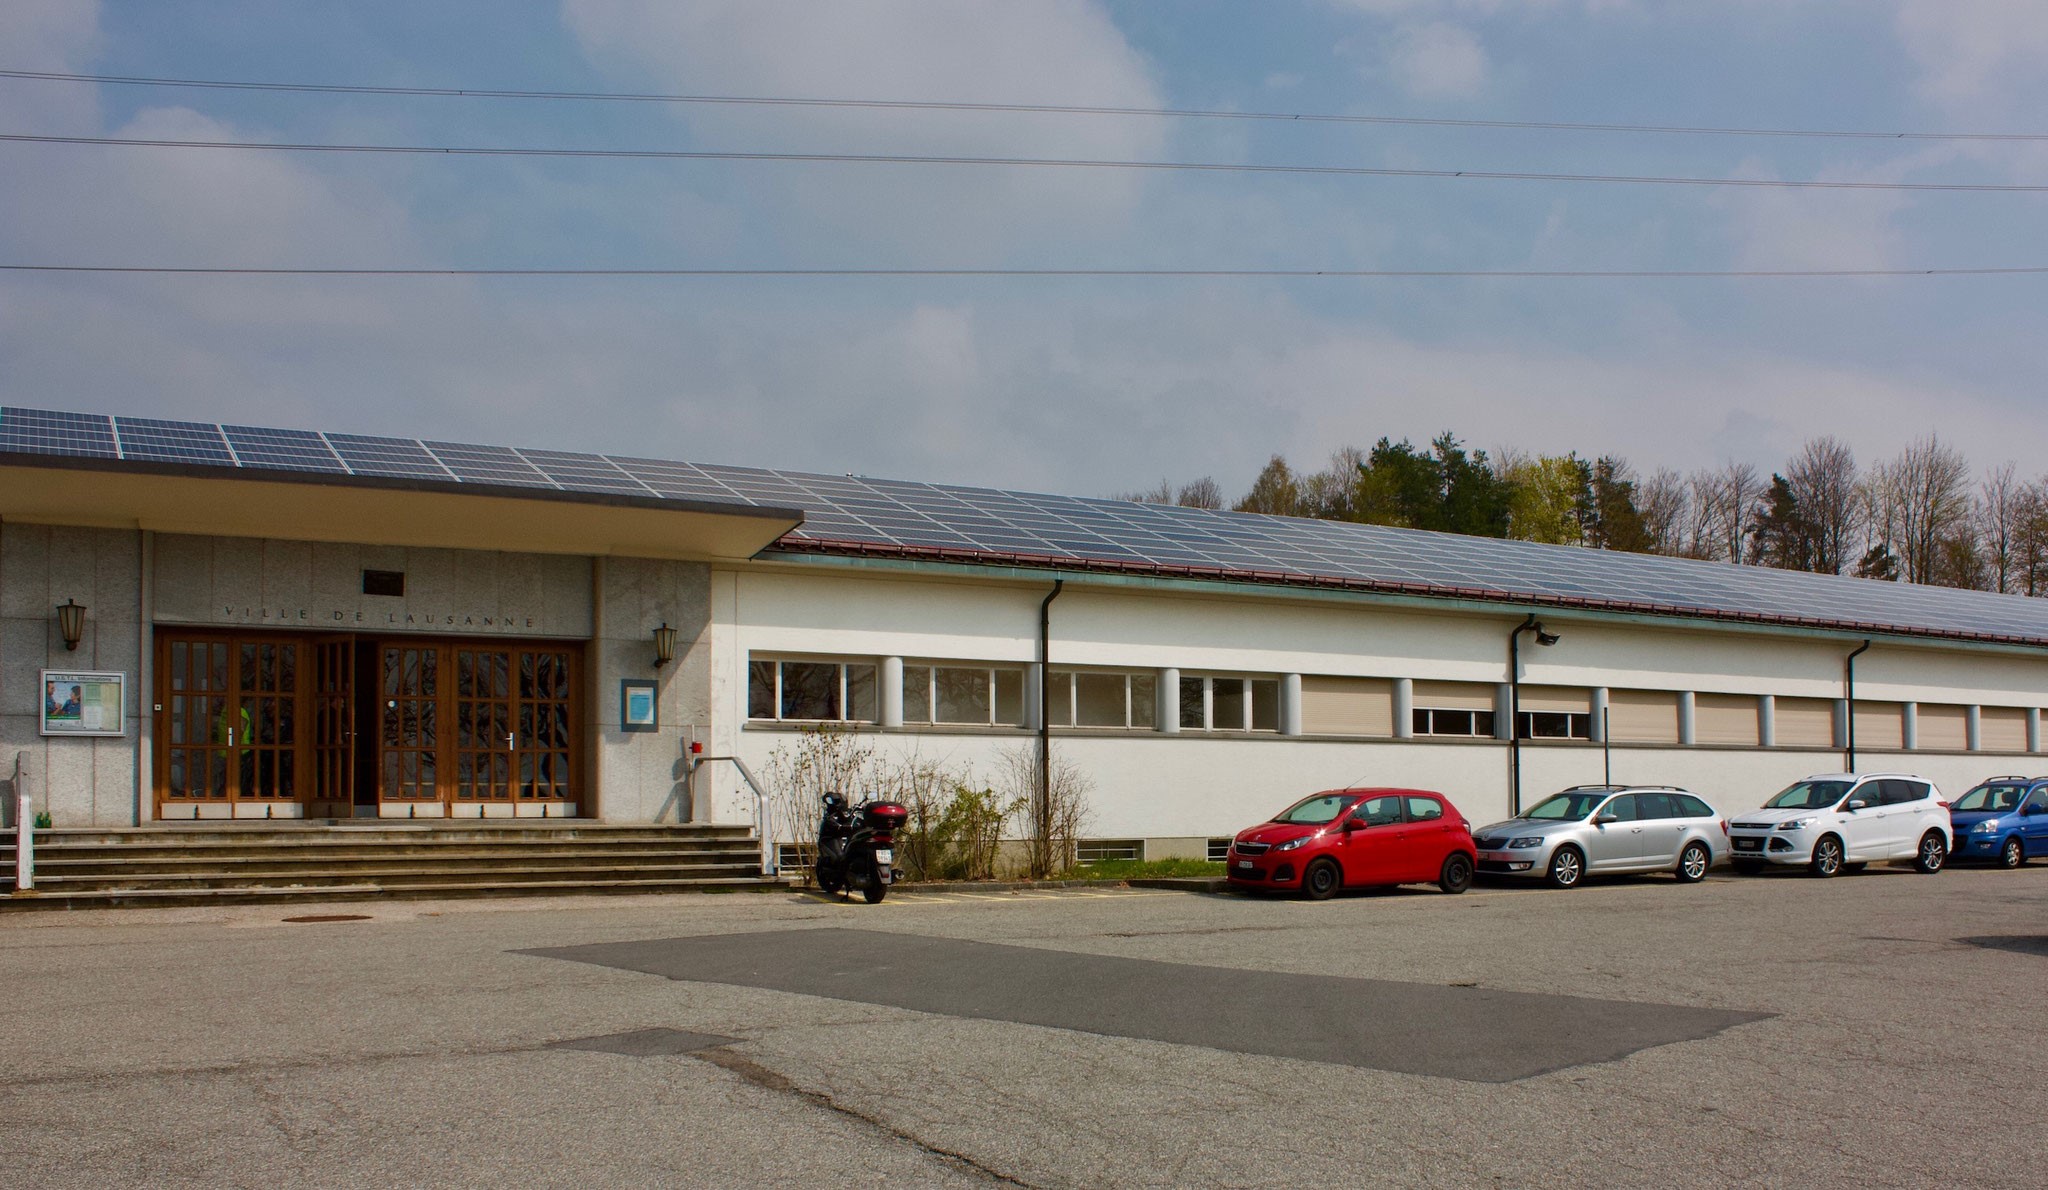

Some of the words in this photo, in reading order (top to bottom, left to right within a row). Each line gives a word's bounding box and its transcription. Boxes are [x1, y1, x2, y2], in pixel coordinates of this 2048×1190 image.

[225, 606, 308, 620] VILLE
[334, 610, 363, 622] DE
[389, 613, 533, 628] LAUSANNE
